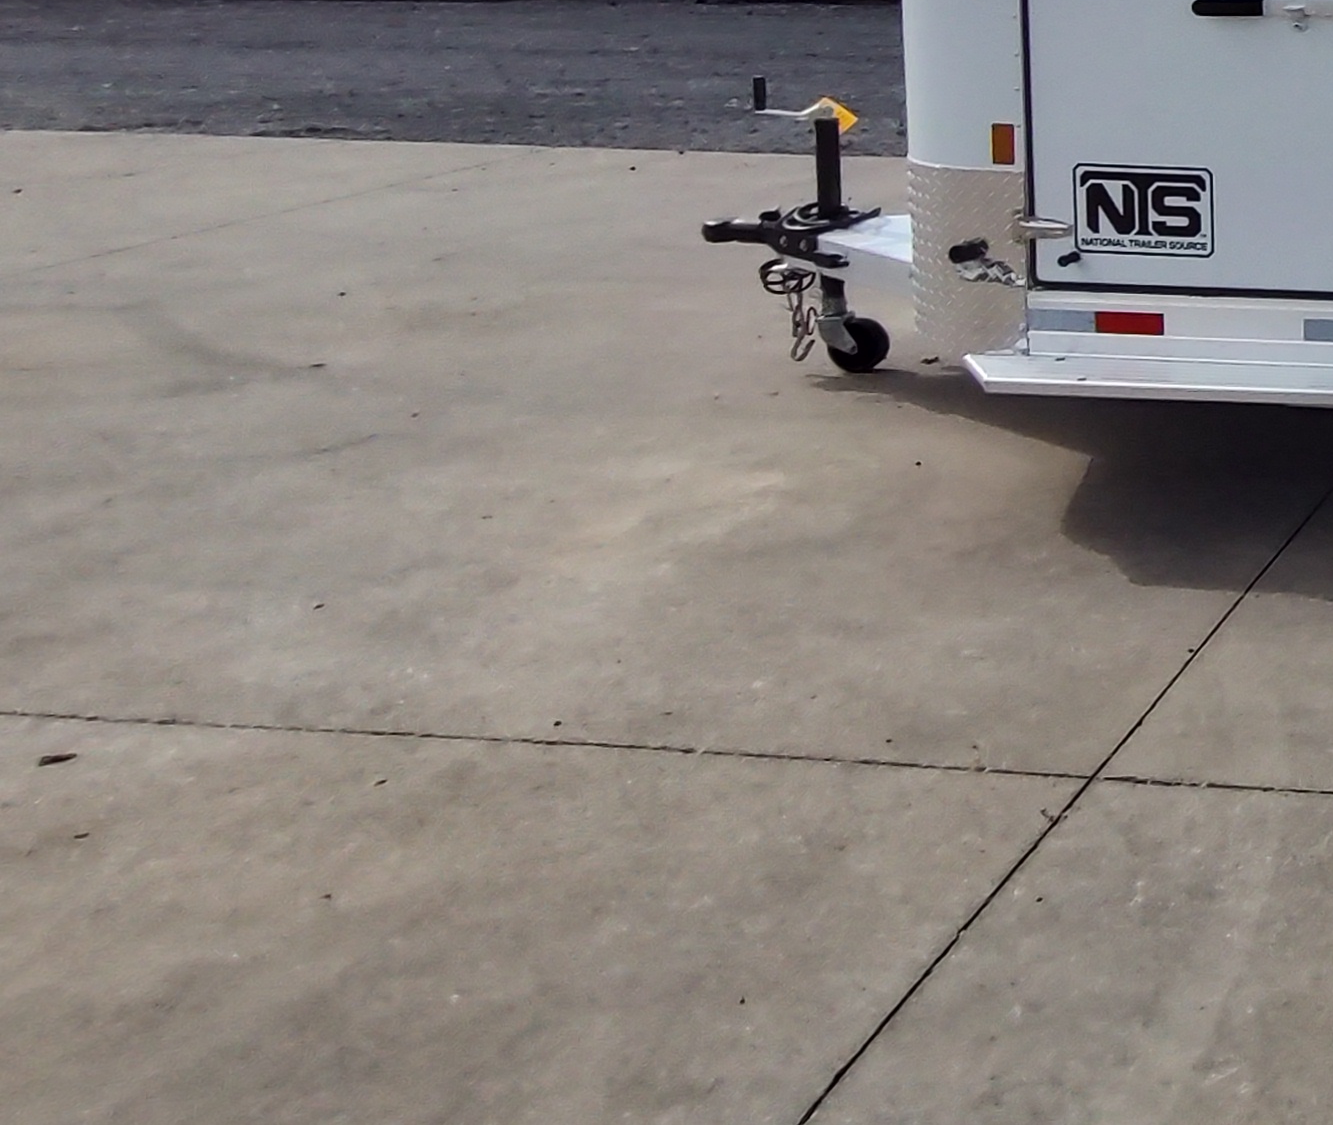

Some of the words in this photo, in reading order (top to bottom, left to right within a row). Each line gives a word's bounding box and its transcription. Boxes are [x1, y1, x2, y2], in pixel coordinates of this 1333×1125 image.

[1080, 170, 1206, 238] NTS
[1081, 237, 1127, 248] NATIONAL
[1128, 239, 1167, 250] TRAILER
[1169, 241, 1208, 252] SOURCE
